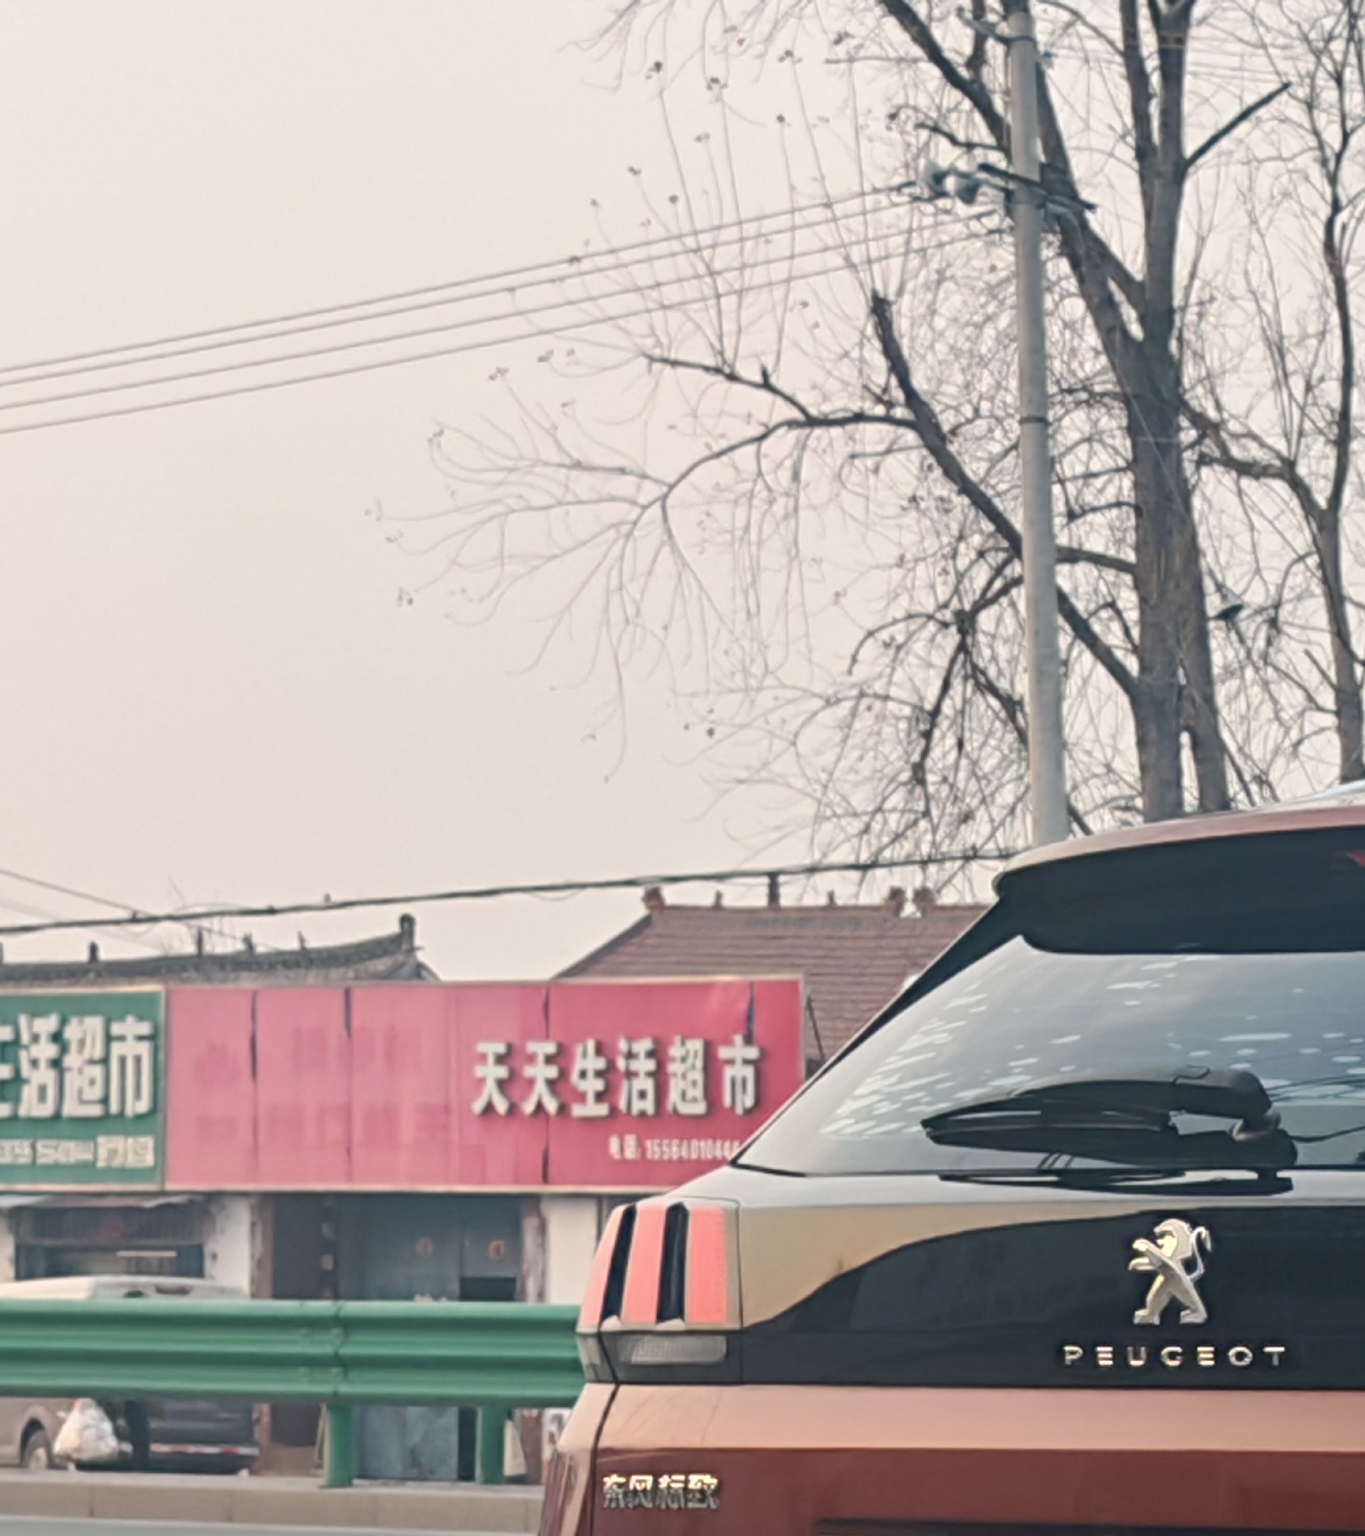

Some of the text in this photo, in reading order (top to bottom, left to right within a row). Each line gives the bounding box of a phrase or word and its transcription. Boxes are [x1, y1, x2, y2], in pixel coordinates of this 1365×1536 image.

[471, 1034, 761, 1118] 天天生活超市
[1062, 1344, 1286, 1368] PEUGEOT
[602, 1473, 719, 1510] 东风标致
